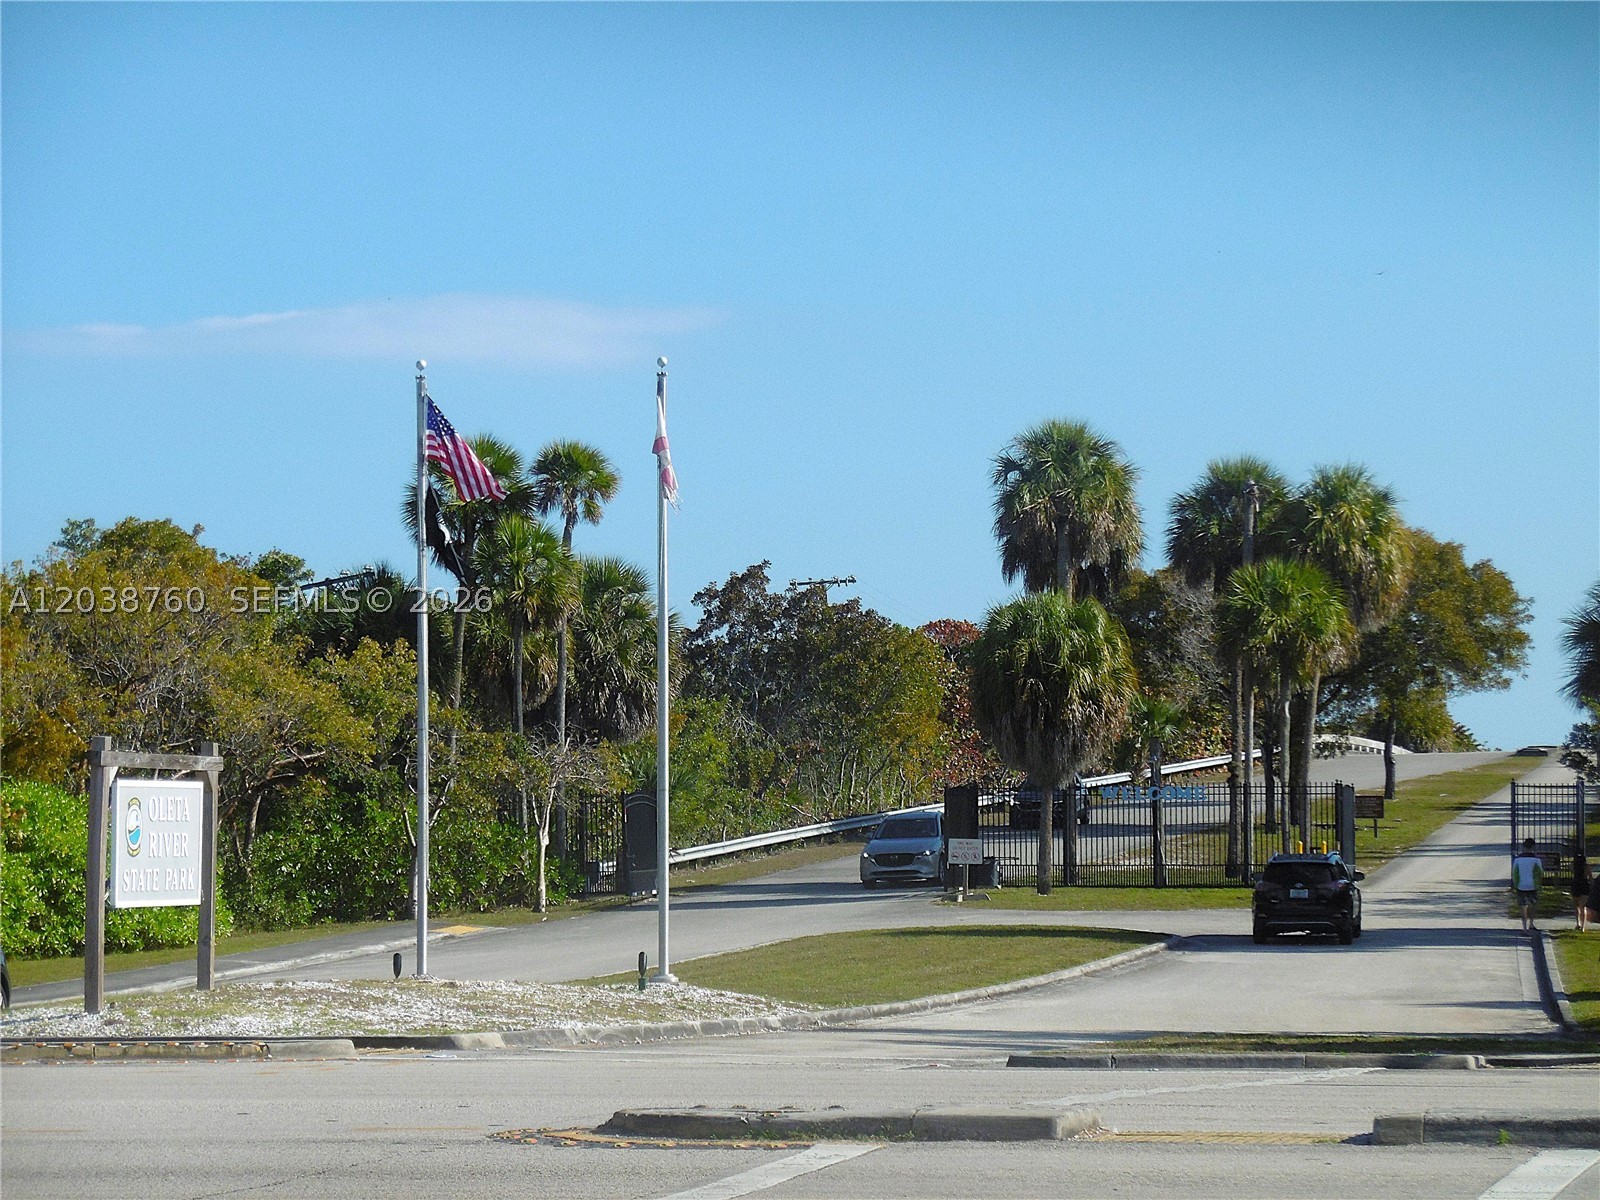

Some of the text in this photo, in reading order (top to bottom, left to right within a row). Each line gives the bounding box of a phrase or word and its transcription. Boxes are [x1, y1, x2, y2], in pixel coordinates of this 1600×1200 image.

[1101, 785, 1208, 801] WELCOME
[147, 796, 191, 822] OLETA
[148, 832, 189, 858] RIVER
[122, 867, 195, 892] STATE PARK
